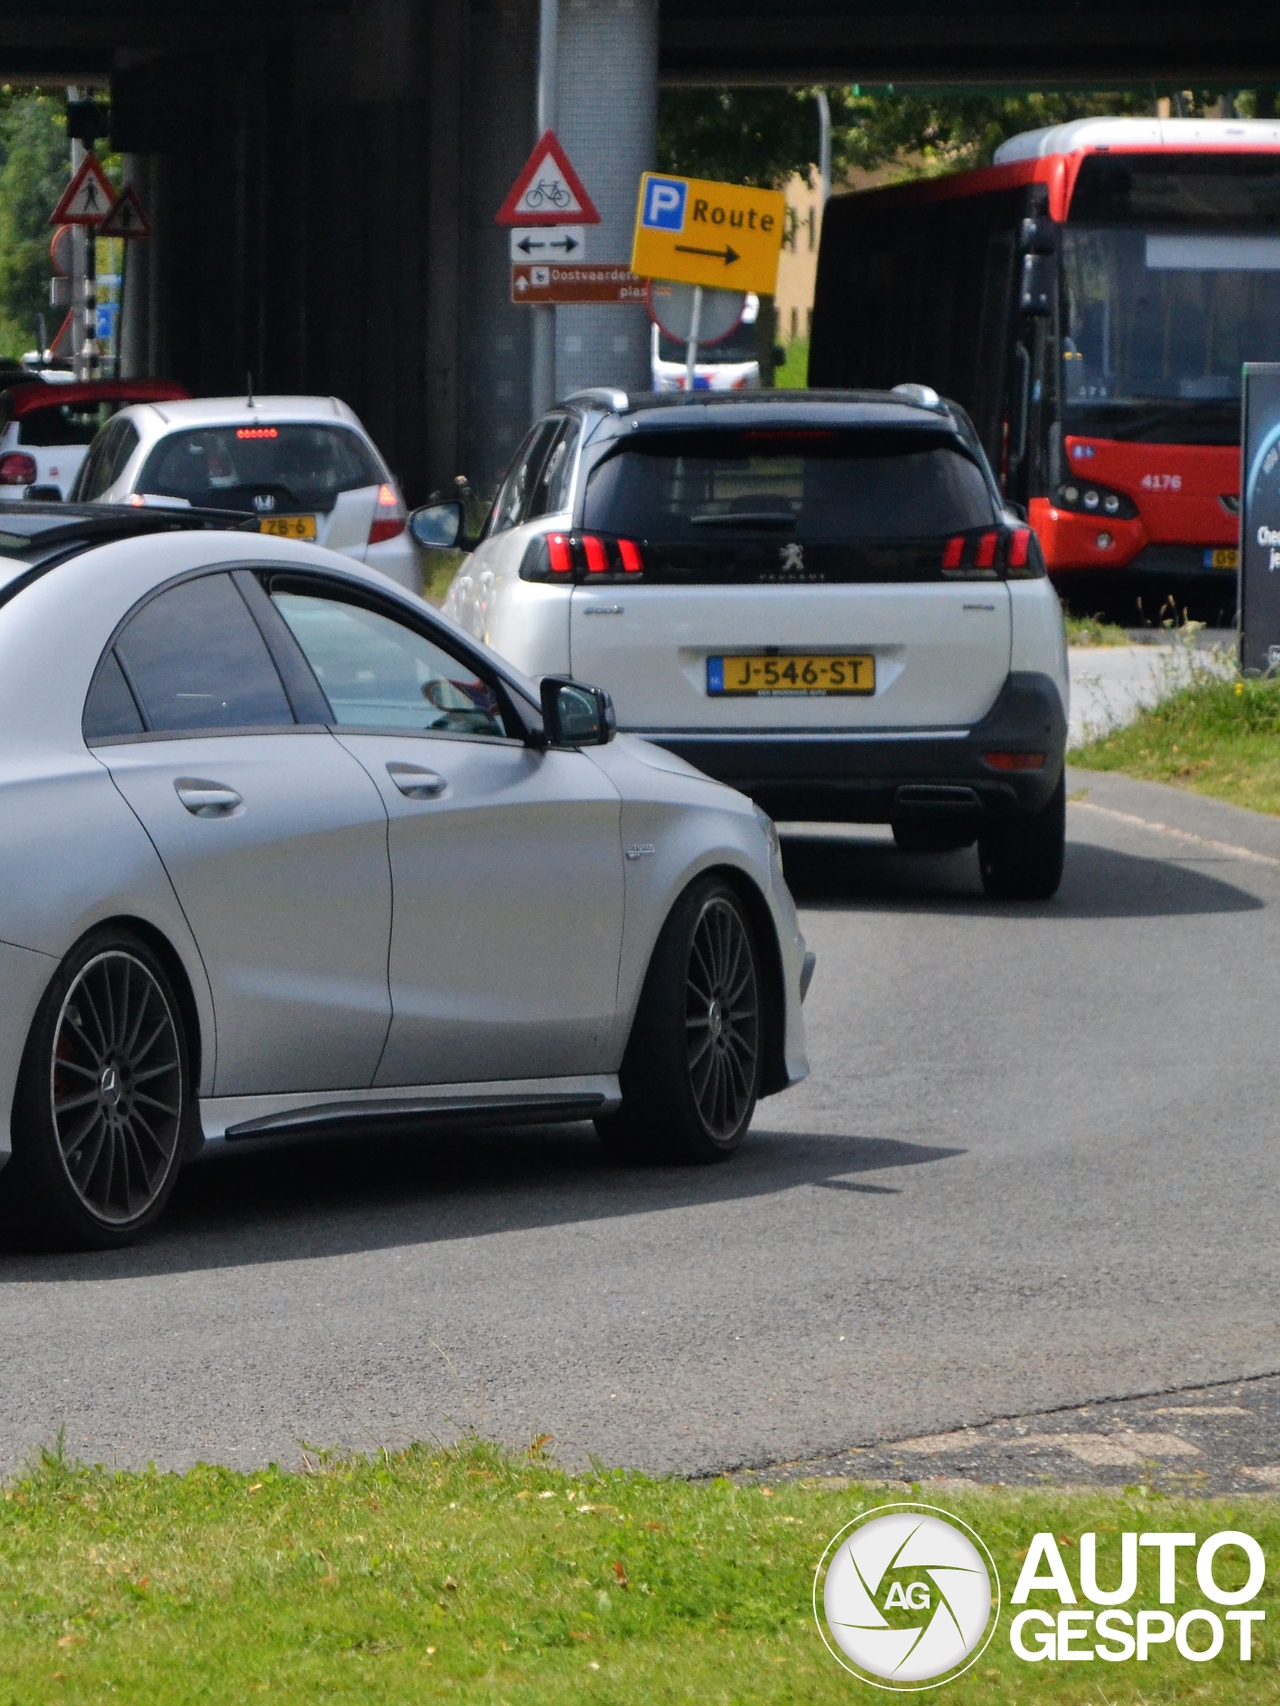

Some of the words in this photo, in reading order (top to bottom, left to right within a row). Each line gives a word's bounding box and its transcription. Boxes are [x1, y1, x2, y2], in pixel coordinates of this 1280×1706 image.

[649, 184, 681, 222] P
[693, 198, 775, 232] Route
[1141, 474, 1183, 492] 4176
[738, 660, 864, 685] J-546-ST
